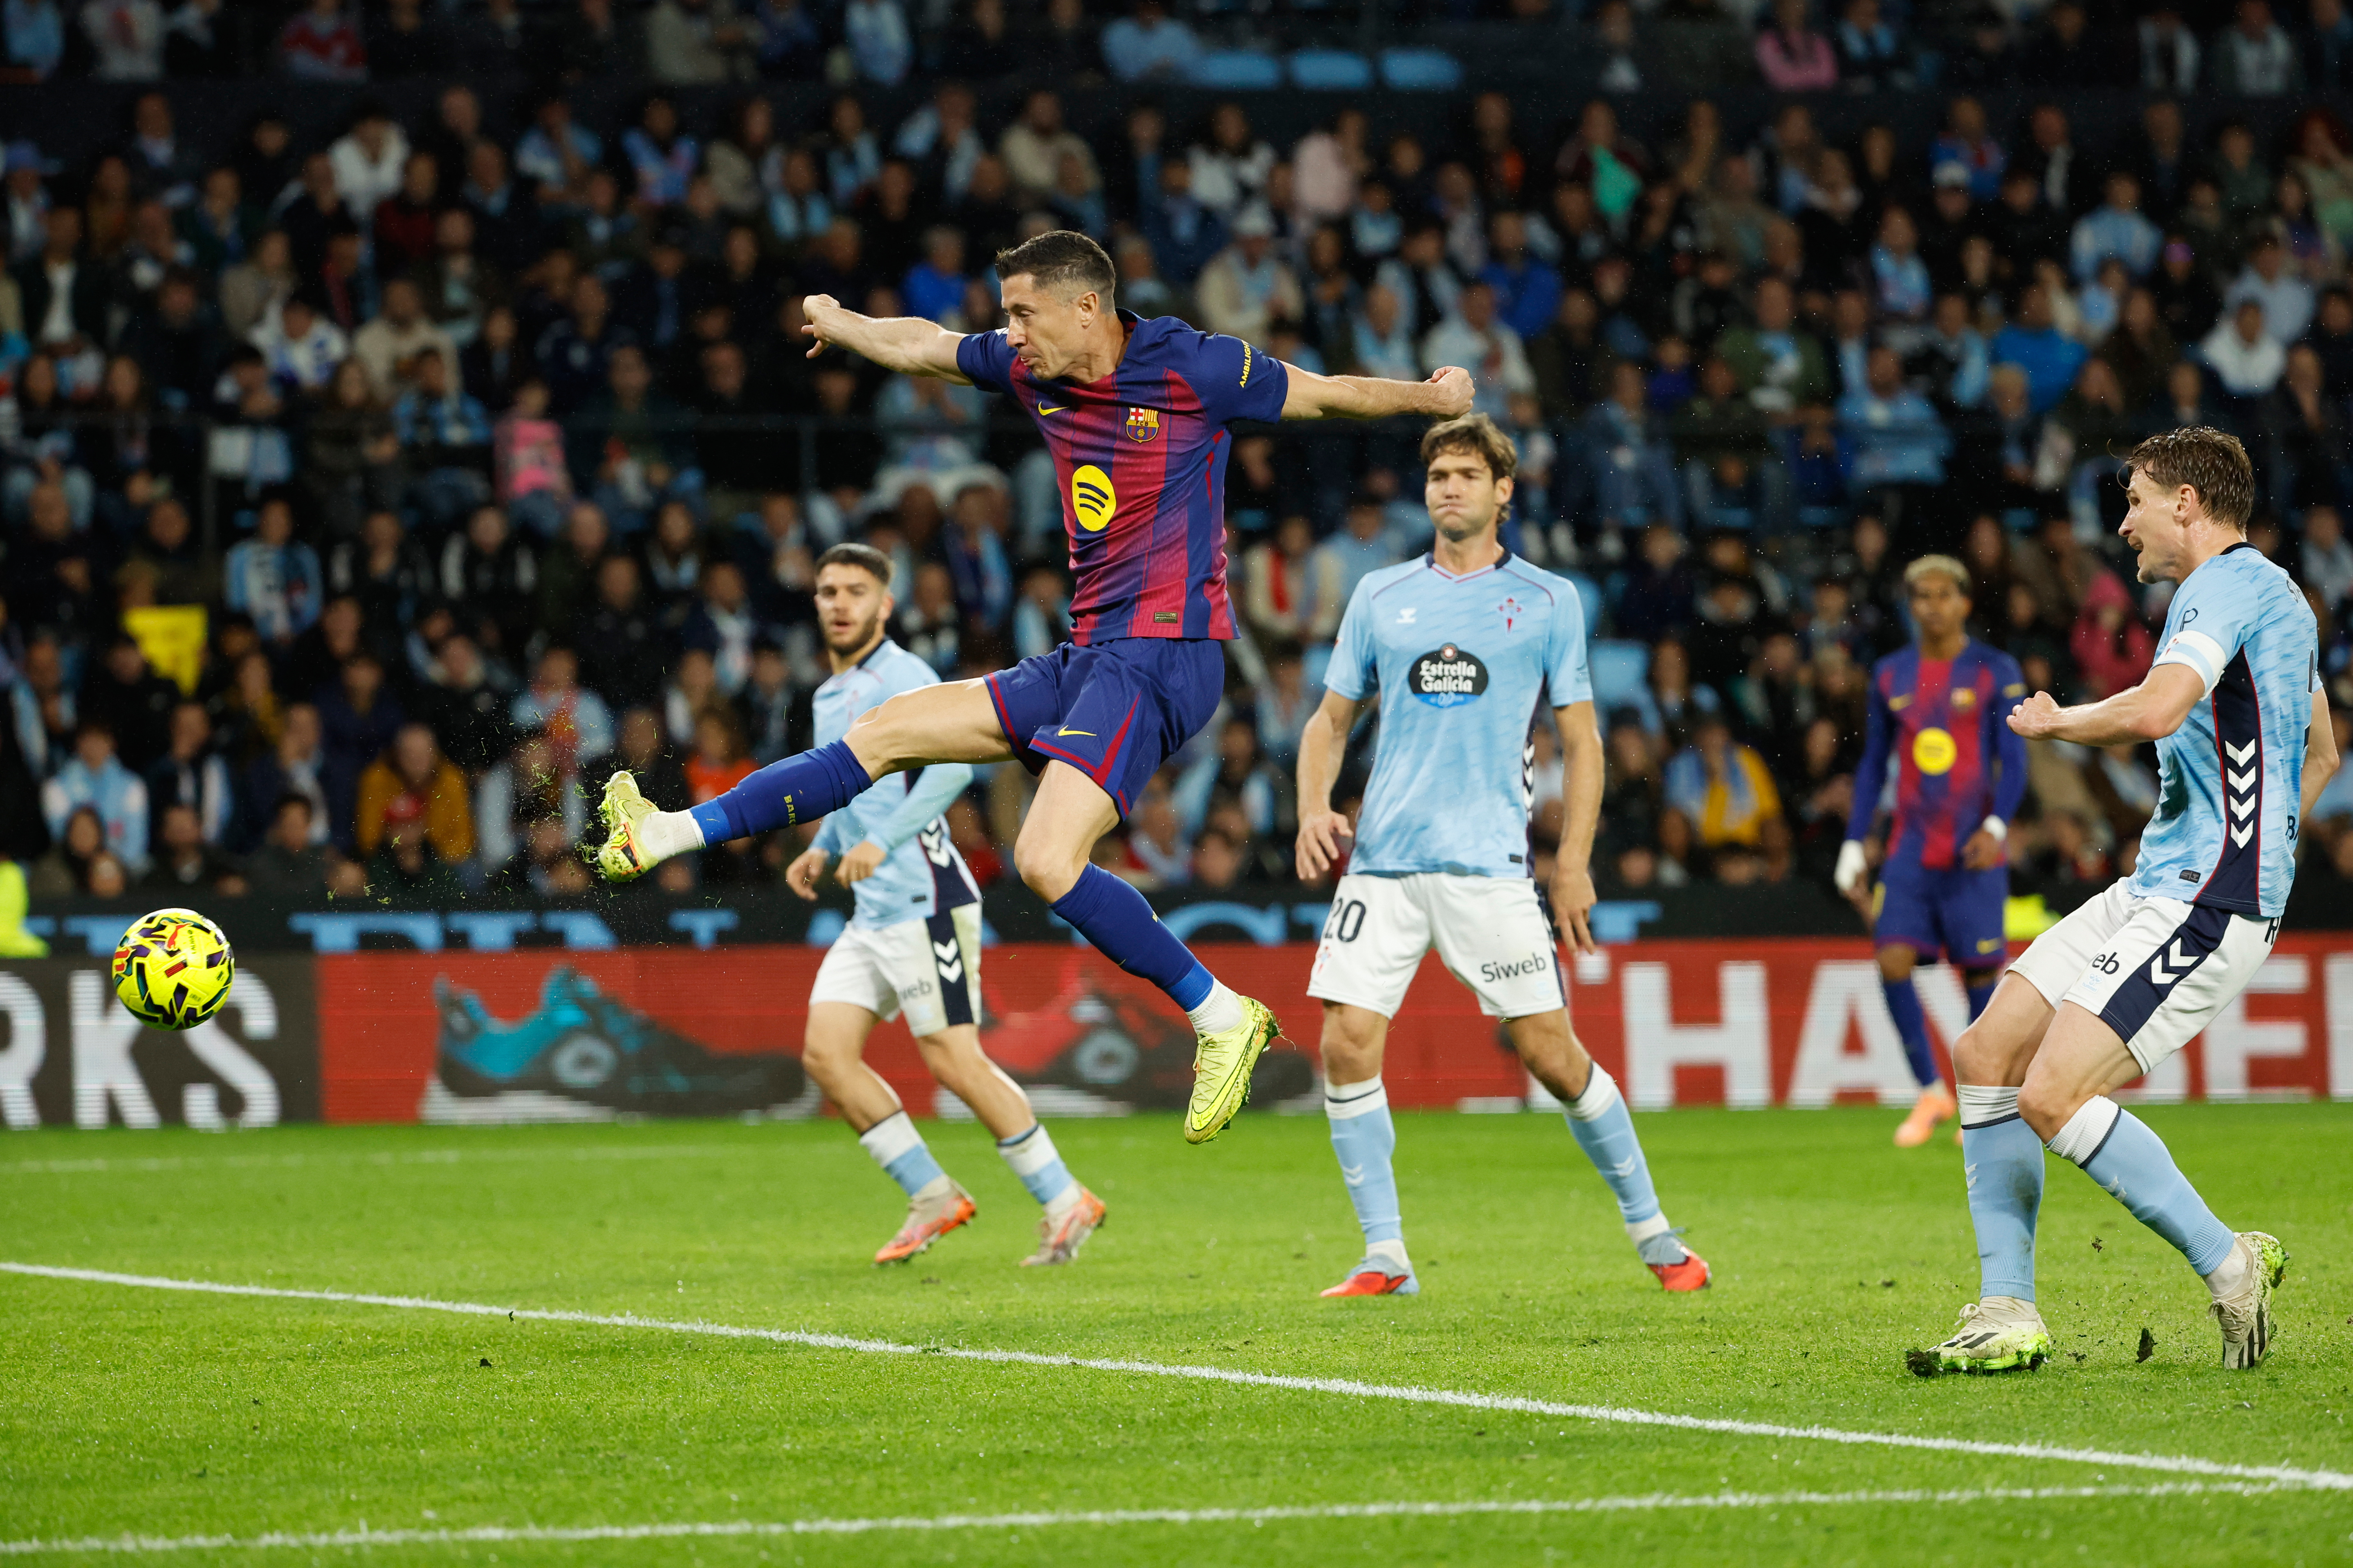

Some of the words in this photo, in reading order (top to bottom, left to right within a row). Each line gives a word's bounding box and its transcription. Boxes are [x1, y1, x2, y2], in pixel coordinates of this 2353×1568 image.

[1419, 660, 1476, 678] Estrella
[1421, 674, 1473, 693] Galicia
[1482, 952, 1546, 983] Siweb
